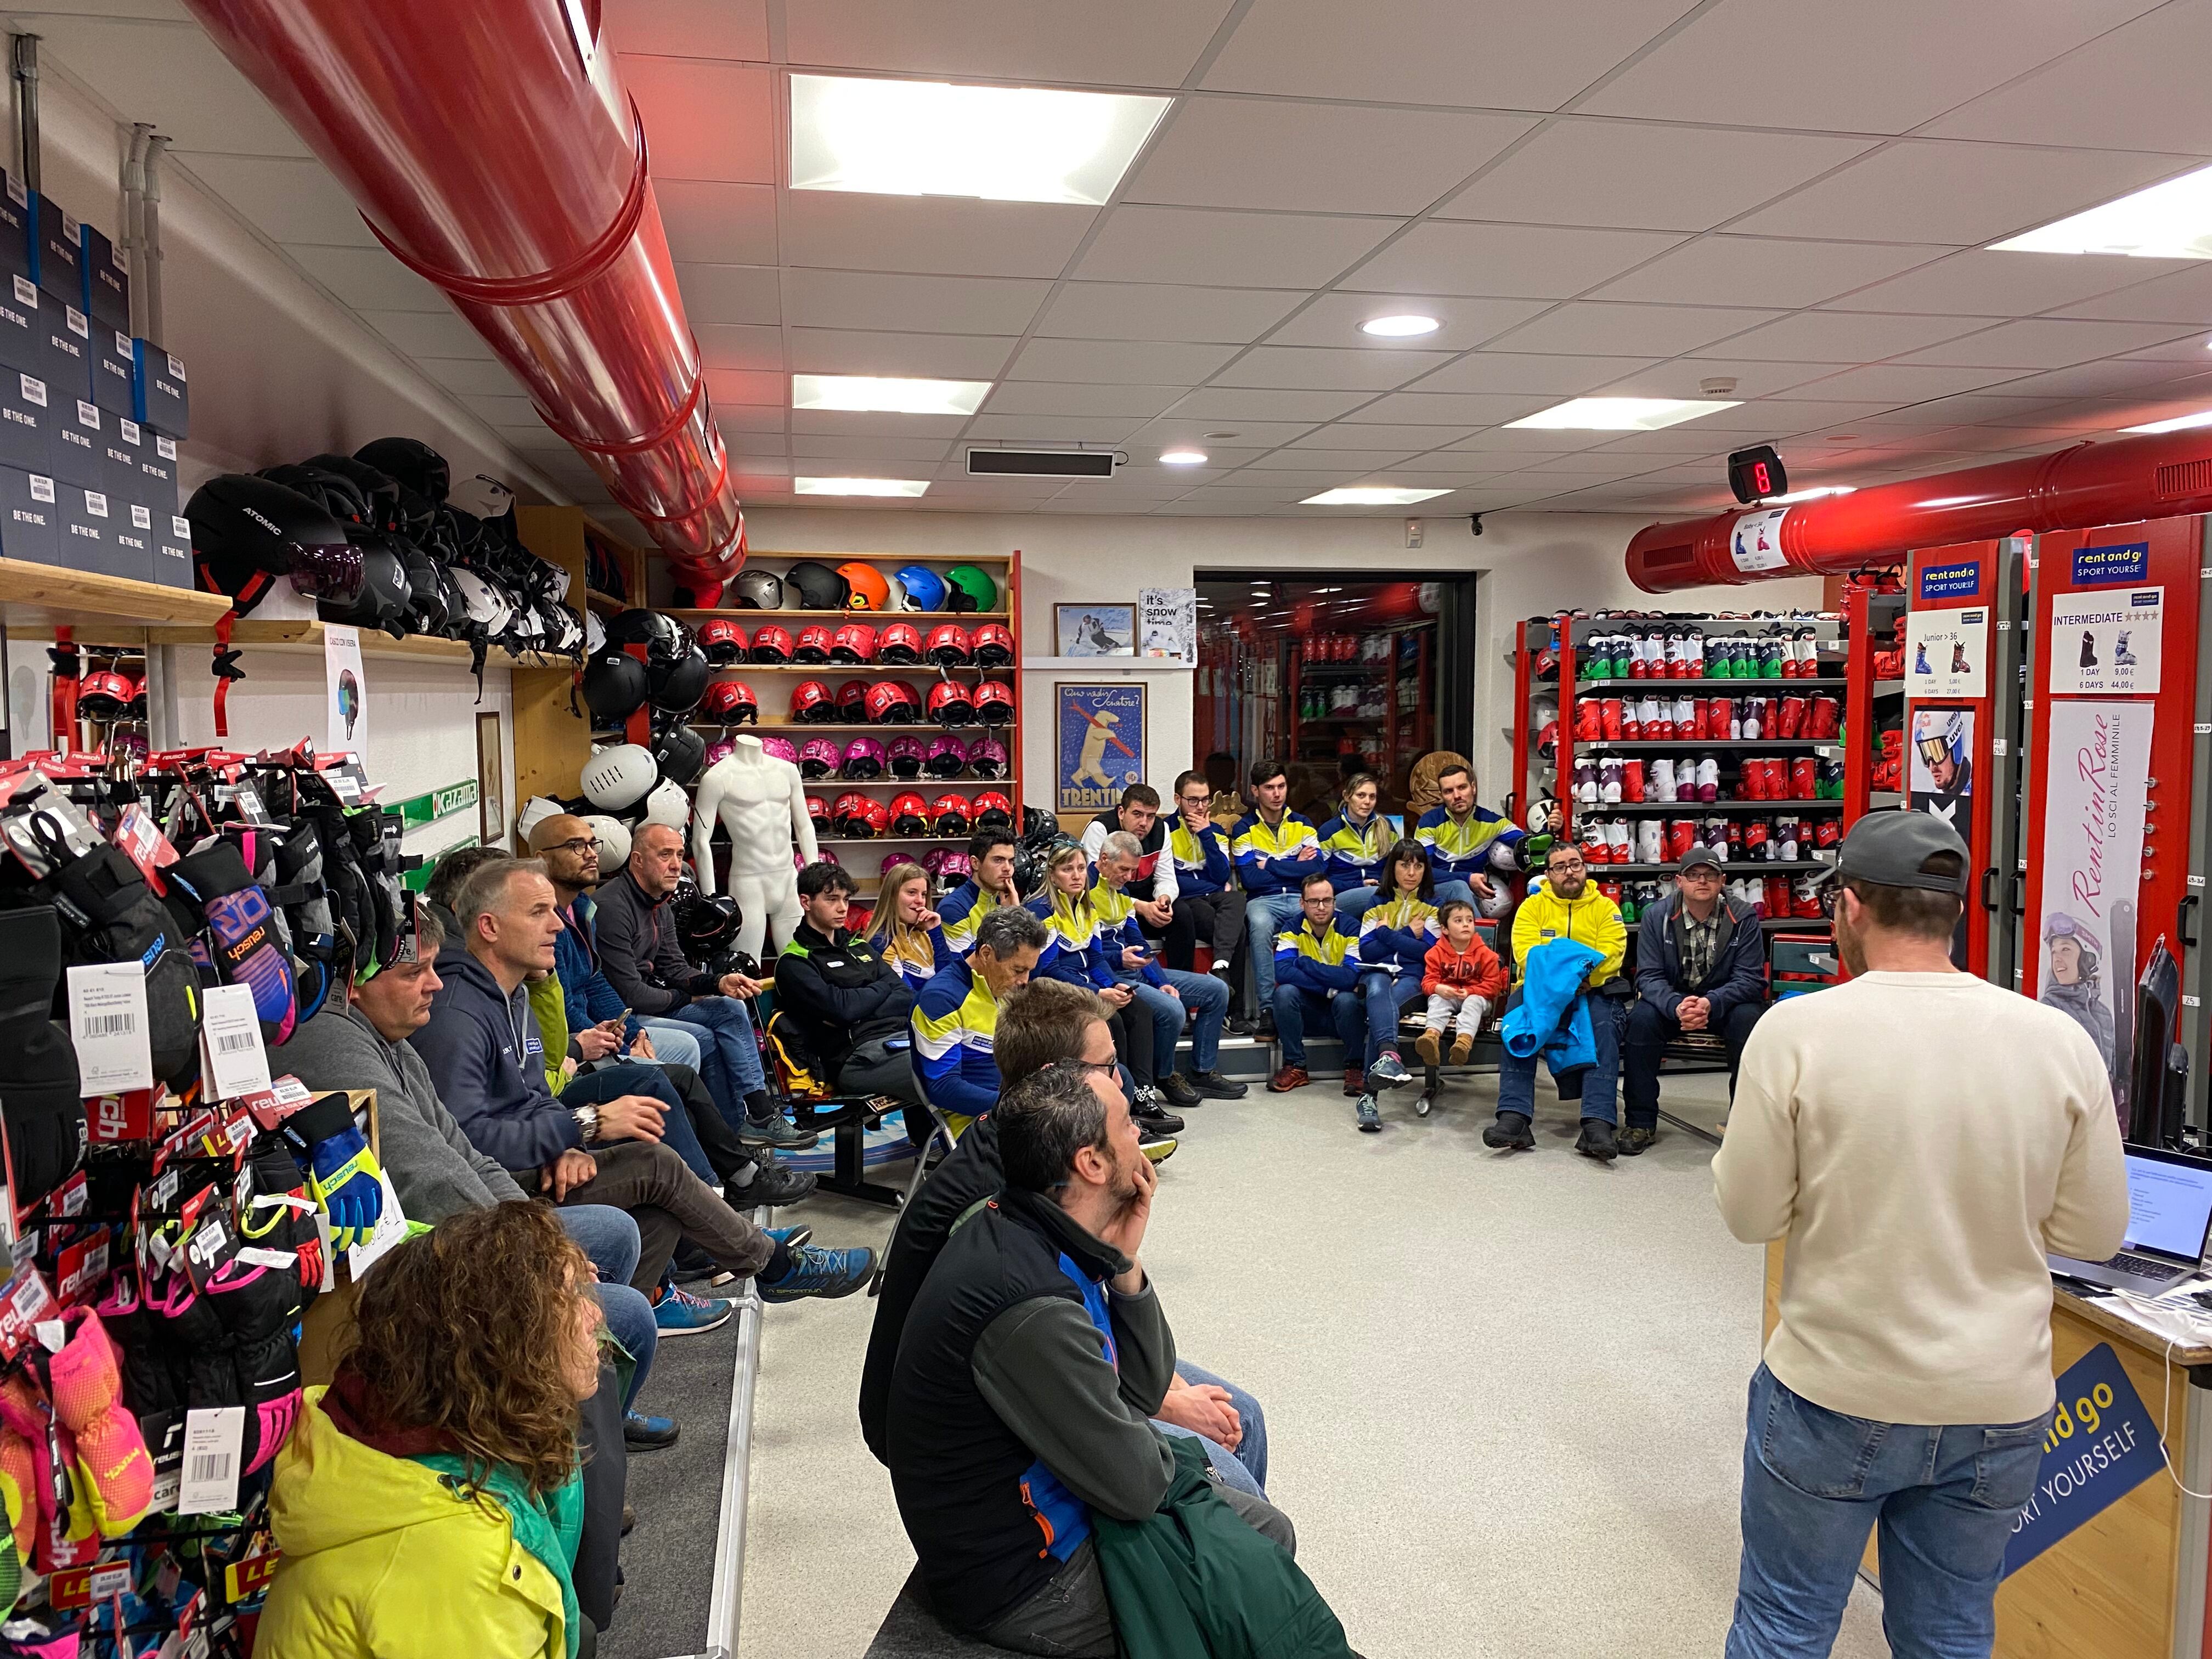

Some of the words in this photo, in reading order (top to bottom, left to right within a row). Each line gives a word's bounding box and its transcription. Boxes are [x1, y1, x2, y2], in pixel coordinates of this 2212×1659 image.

[5, 309, 15, 321] THE
[15, 313, 28, 328] ONE.
[52, 335, 59, 347] BE
[59, 338, 69, 352] THE
[103, 359, 109, 370] BE
[109, 362, 117, 374] THE
[156, 379, 162, 390] BE
[162, 382, 171, 394] THE
[3, 408, 12, 420] BE
[11, 410, 23, 424] THE
[23, 414, 37, 427] ONE.
[61, 429, 69, 441] BE
[69, 432, 80, 444] THE
[80, 436, 91, 448] ONE.
[107, 448, 114, 458] BE
[114, 450, 122, 461] THE
[122, 453, 132, 465] ONE.
[142, 463, 149, 473] BE
[149, 466, 157, 477] THE
[157, 469, 167, 479] ONE.
[13, 509, 21, 521] BE
[21, 511, 33, 523] THE
[33, 514, 46, 526] ONE.
[242, 506, 282, 537] ATOMIC
[71, 524, 78, 534] BE
[78, 526, 88, 537] THE
[88, 528, 100, 539] ONE.
[118, 535, 125, 545] BE
[125, 537, 134, 547] THE
[133, 539, 144, 549] ONE.
[161, 546, 168, 555] BE
[167, 547, 176, 556] THE
[176, 549, 185, 559] ONE.
[2078, 552, 2105, 563] rent
[2108, 550, 2130, 562] and
[2132, 551, 2141, 562] g
[1926, 571, 1948, 580] rent
[1949, 568, 1967, 579] and
[2078, 567, 2104, 576] SPORT
[2108, 565, 2141, 574] YOURSE
[1925, 583, 1948, 592] SPORT
[1146, 595, 1163, 605] it's
[1146, 607, 1177, 616] snow
[2054, 613, 2123, 625] INTERMEDIATE
[1924, 633, 1943, 642] Junior
[1064, 687, 1085, 698] Quo
[1089, 686, 1110, 698] vadis
[1946, 712, 1957, 727] uvex
[1950, 721, 1963, 742] uvex
[2111, 714, 2120, 778] FEMMINILE
[71, 752, 100, 761] reusch
[162, 752, 187, 760] reusch
[41, 761, 66, 774] reusch
[1062, 787, 1123, 806] TRENTIN
[2110, 782, 2118, 797] AL
[437, 782, 477, 815] kazama
[2109, 801, 2117, 818] SCI
[2108, 823, 2116, 838] LO
[134, 840, 149, 866] reu
[142, 932, 165, 966] reus
[227, 926, 265, 960] reusch
[331, 994, 343, 1003] care
[252, 1098, 278, 1111] reu
[323, 1160, 358, 1190] reusch
[59, 1269, 82, 1297] reu
[0, 1309, 22, 1341] reu
[2043, 1402, 2074, 1453] nd
[2076, 1383, 2113, 1434] go
[153, 1451, 183, 1465] reus
[2041, 1421, 2136, 1505] YOURSELF
[246, 1557, 278, 1582] LE
[63, 1576, 91, 1597] LE
